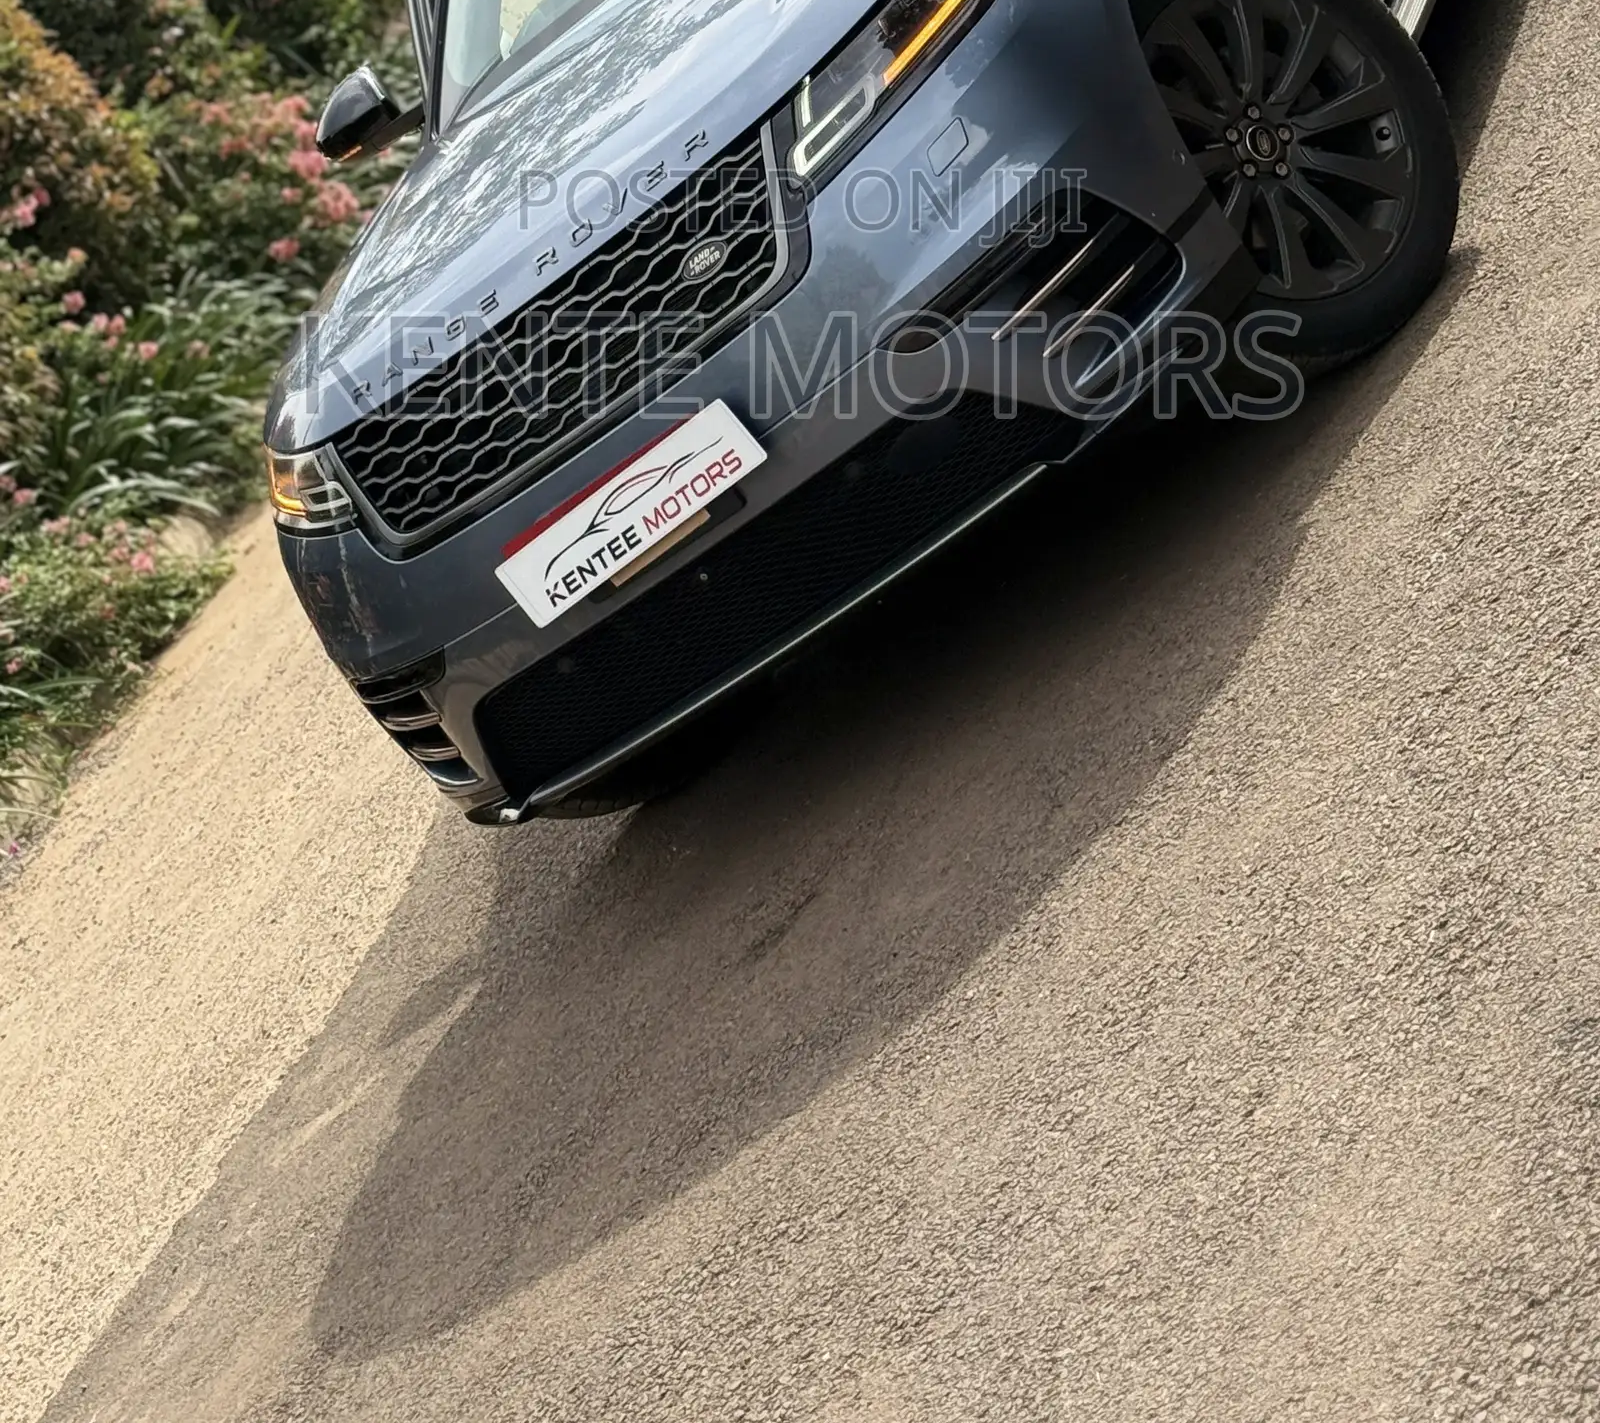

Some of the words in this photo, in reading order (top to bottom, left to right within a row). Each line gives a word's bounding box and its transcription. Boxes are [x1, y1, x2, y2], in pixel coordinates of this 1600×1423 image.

[352, 289, 500, 406] RANGE
[533, 129, 709, 276] ROVER
[689, 248, 710, 269] LAND
[694, 250, 721, 274] ROVER
[545, 524, 643, 608] KENTEE
[641, 448, 743, 536] MOTORS
